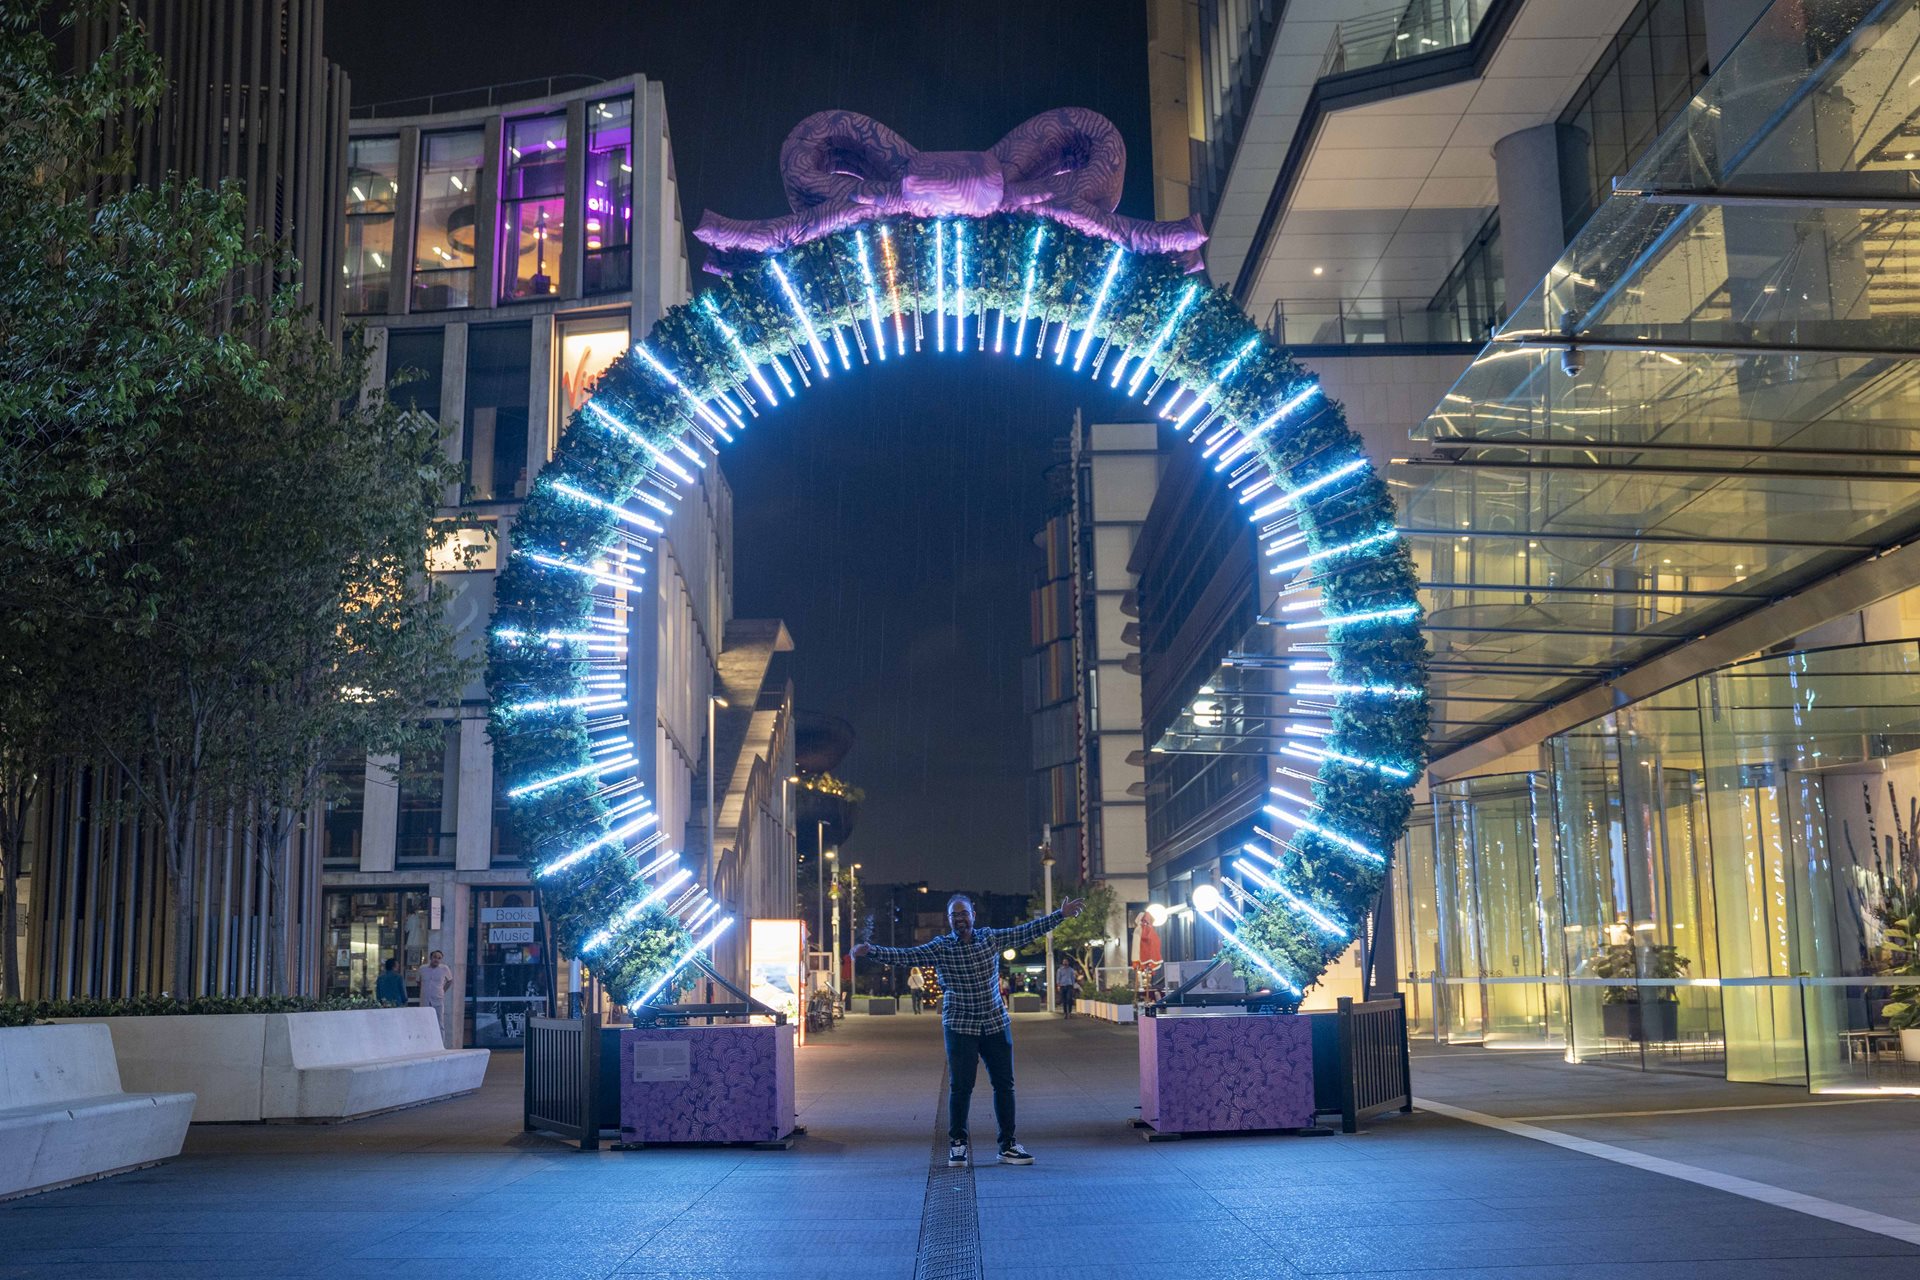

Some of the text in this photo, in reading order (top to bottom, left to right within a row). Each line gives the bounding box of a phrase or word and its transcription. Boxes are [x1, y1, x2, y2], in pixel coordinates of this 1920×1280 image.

[496, 909, 534, 921] Books
[493, 930, 530, 942] Music
[506, 1029, 521, 1039] VIP
